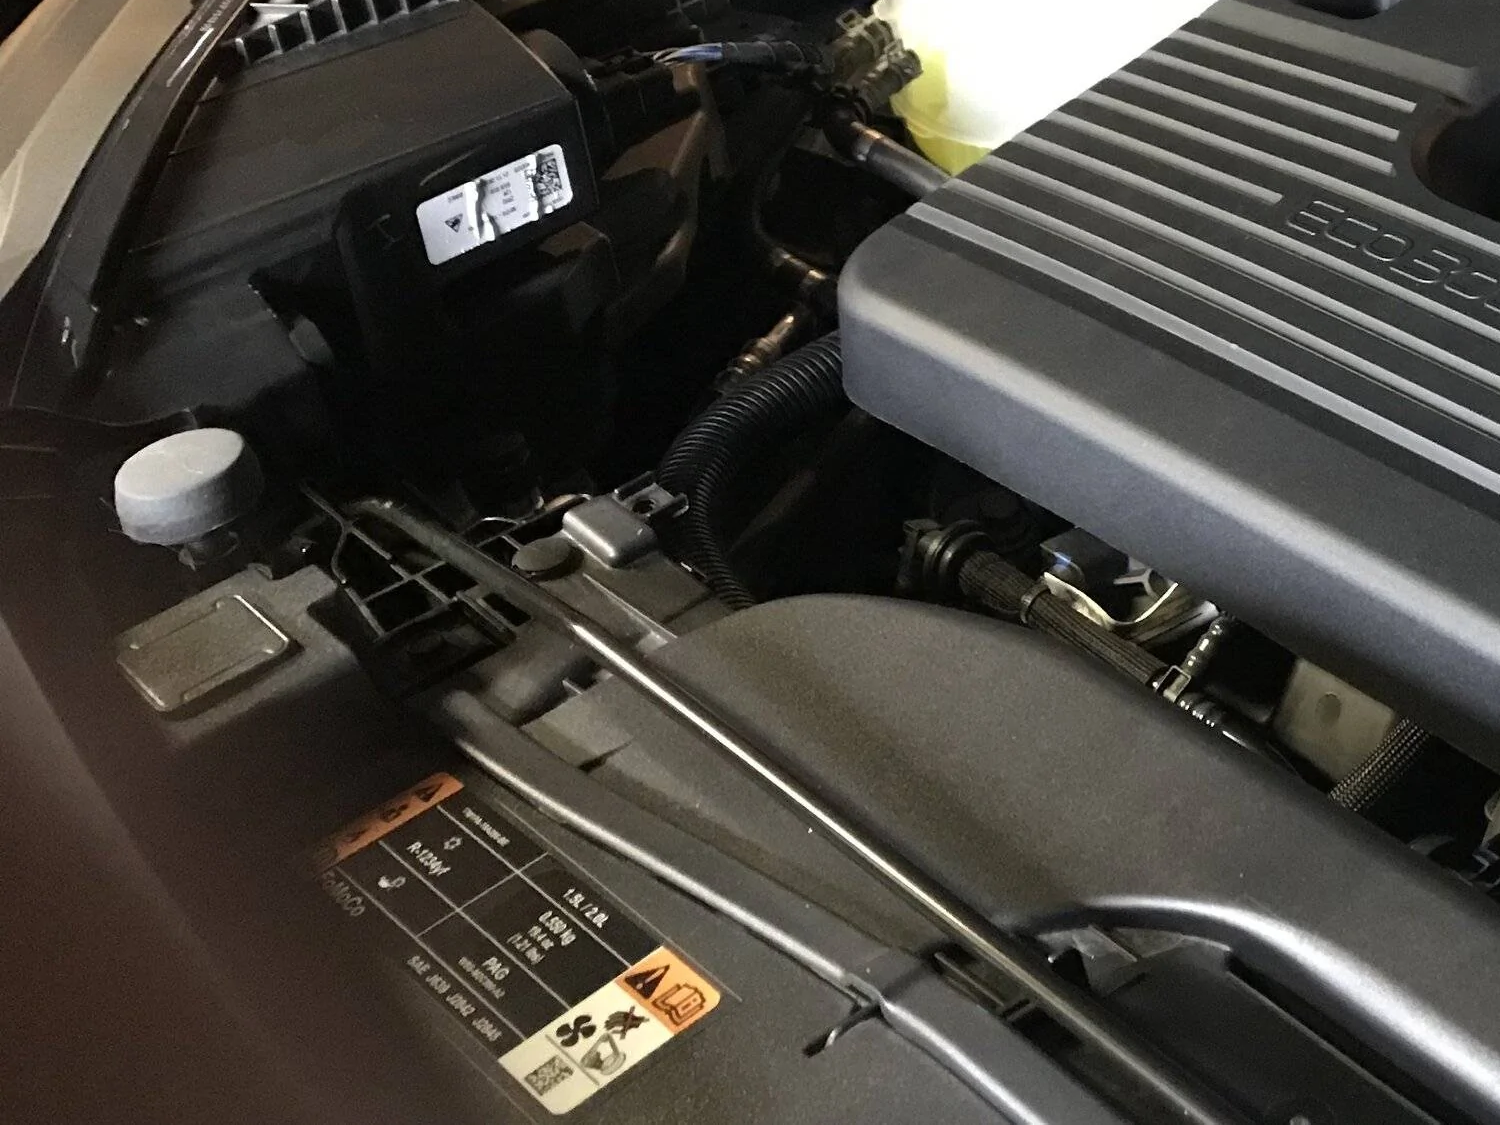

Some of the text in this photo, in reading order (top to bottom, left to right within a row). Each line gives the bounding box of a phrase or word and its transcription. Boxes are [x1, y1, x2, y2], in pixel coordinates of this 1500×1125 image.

[406, 841, 452, 877] R-1234yf
[407, 956, 431, 975] SAE
[482, 957, 510, 981] PAG
